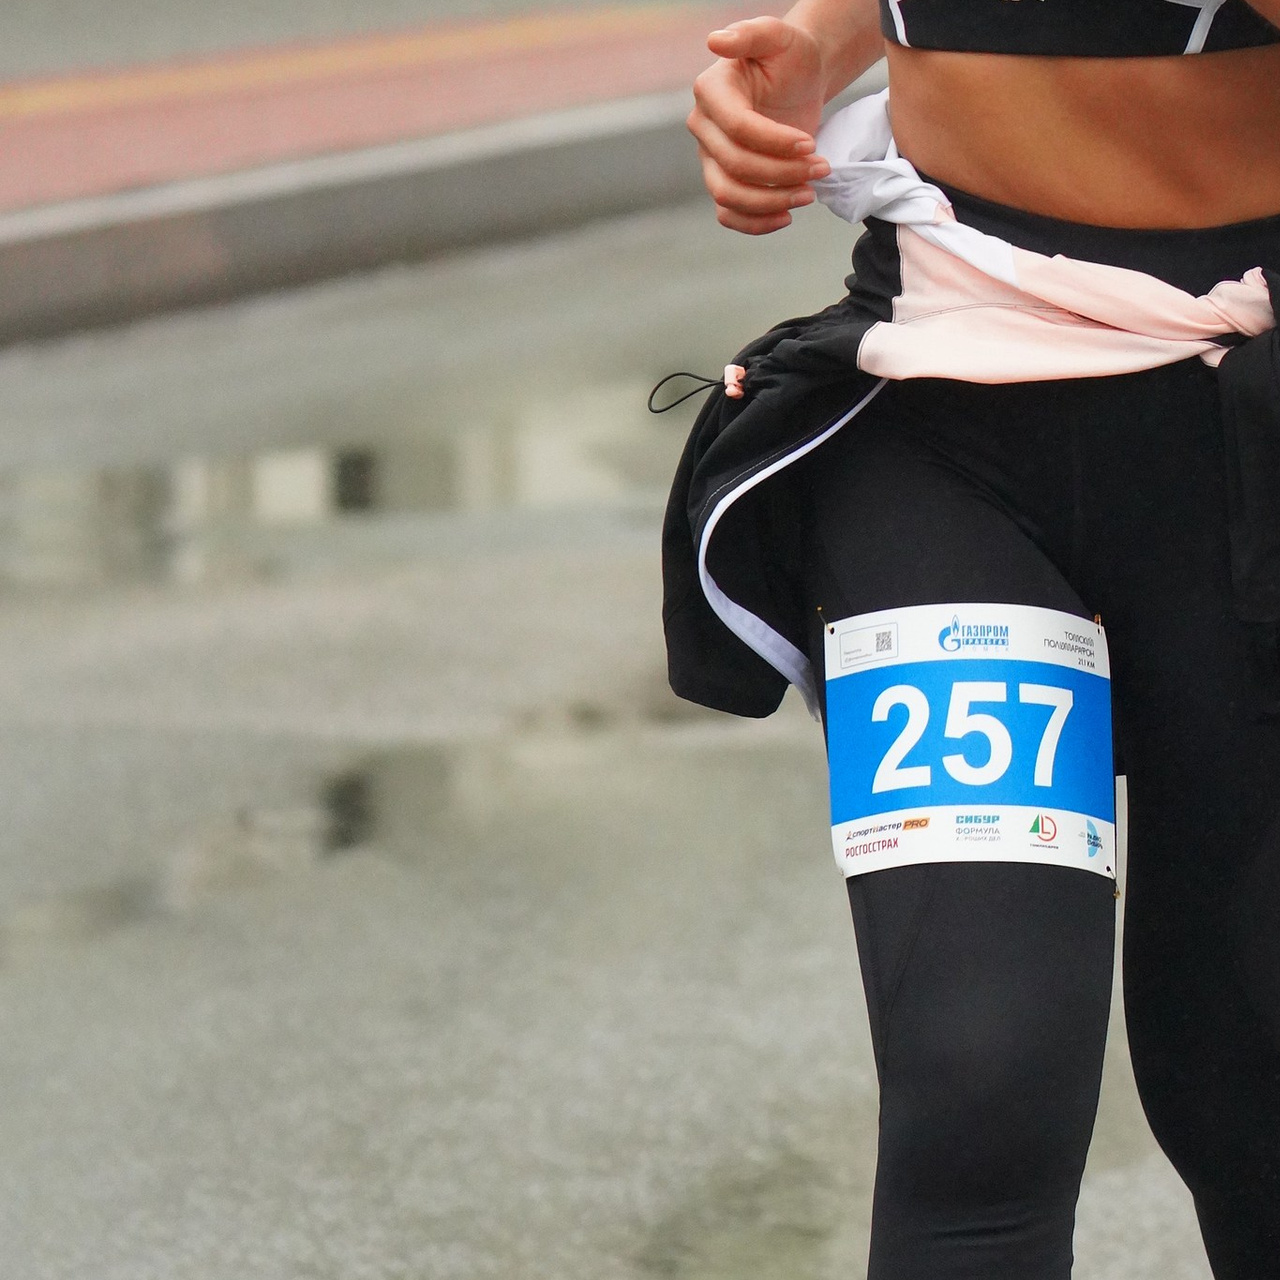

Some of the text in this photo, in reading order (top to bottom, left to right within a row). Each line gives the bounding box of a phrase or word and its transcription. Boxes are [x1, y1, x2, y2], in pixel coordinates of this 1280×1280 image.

[962, 625, 1009, 637] ГАЗПРОМ
[871, 681, 1074, 794] 257
[903, 819, 928, 830] PRO
[955, 815, 1000, 824] СИБУР
[955, 827, 1001, 835] ФОРМУЛА
[845, 837, 899, 859] РОСГОССТРАХ
